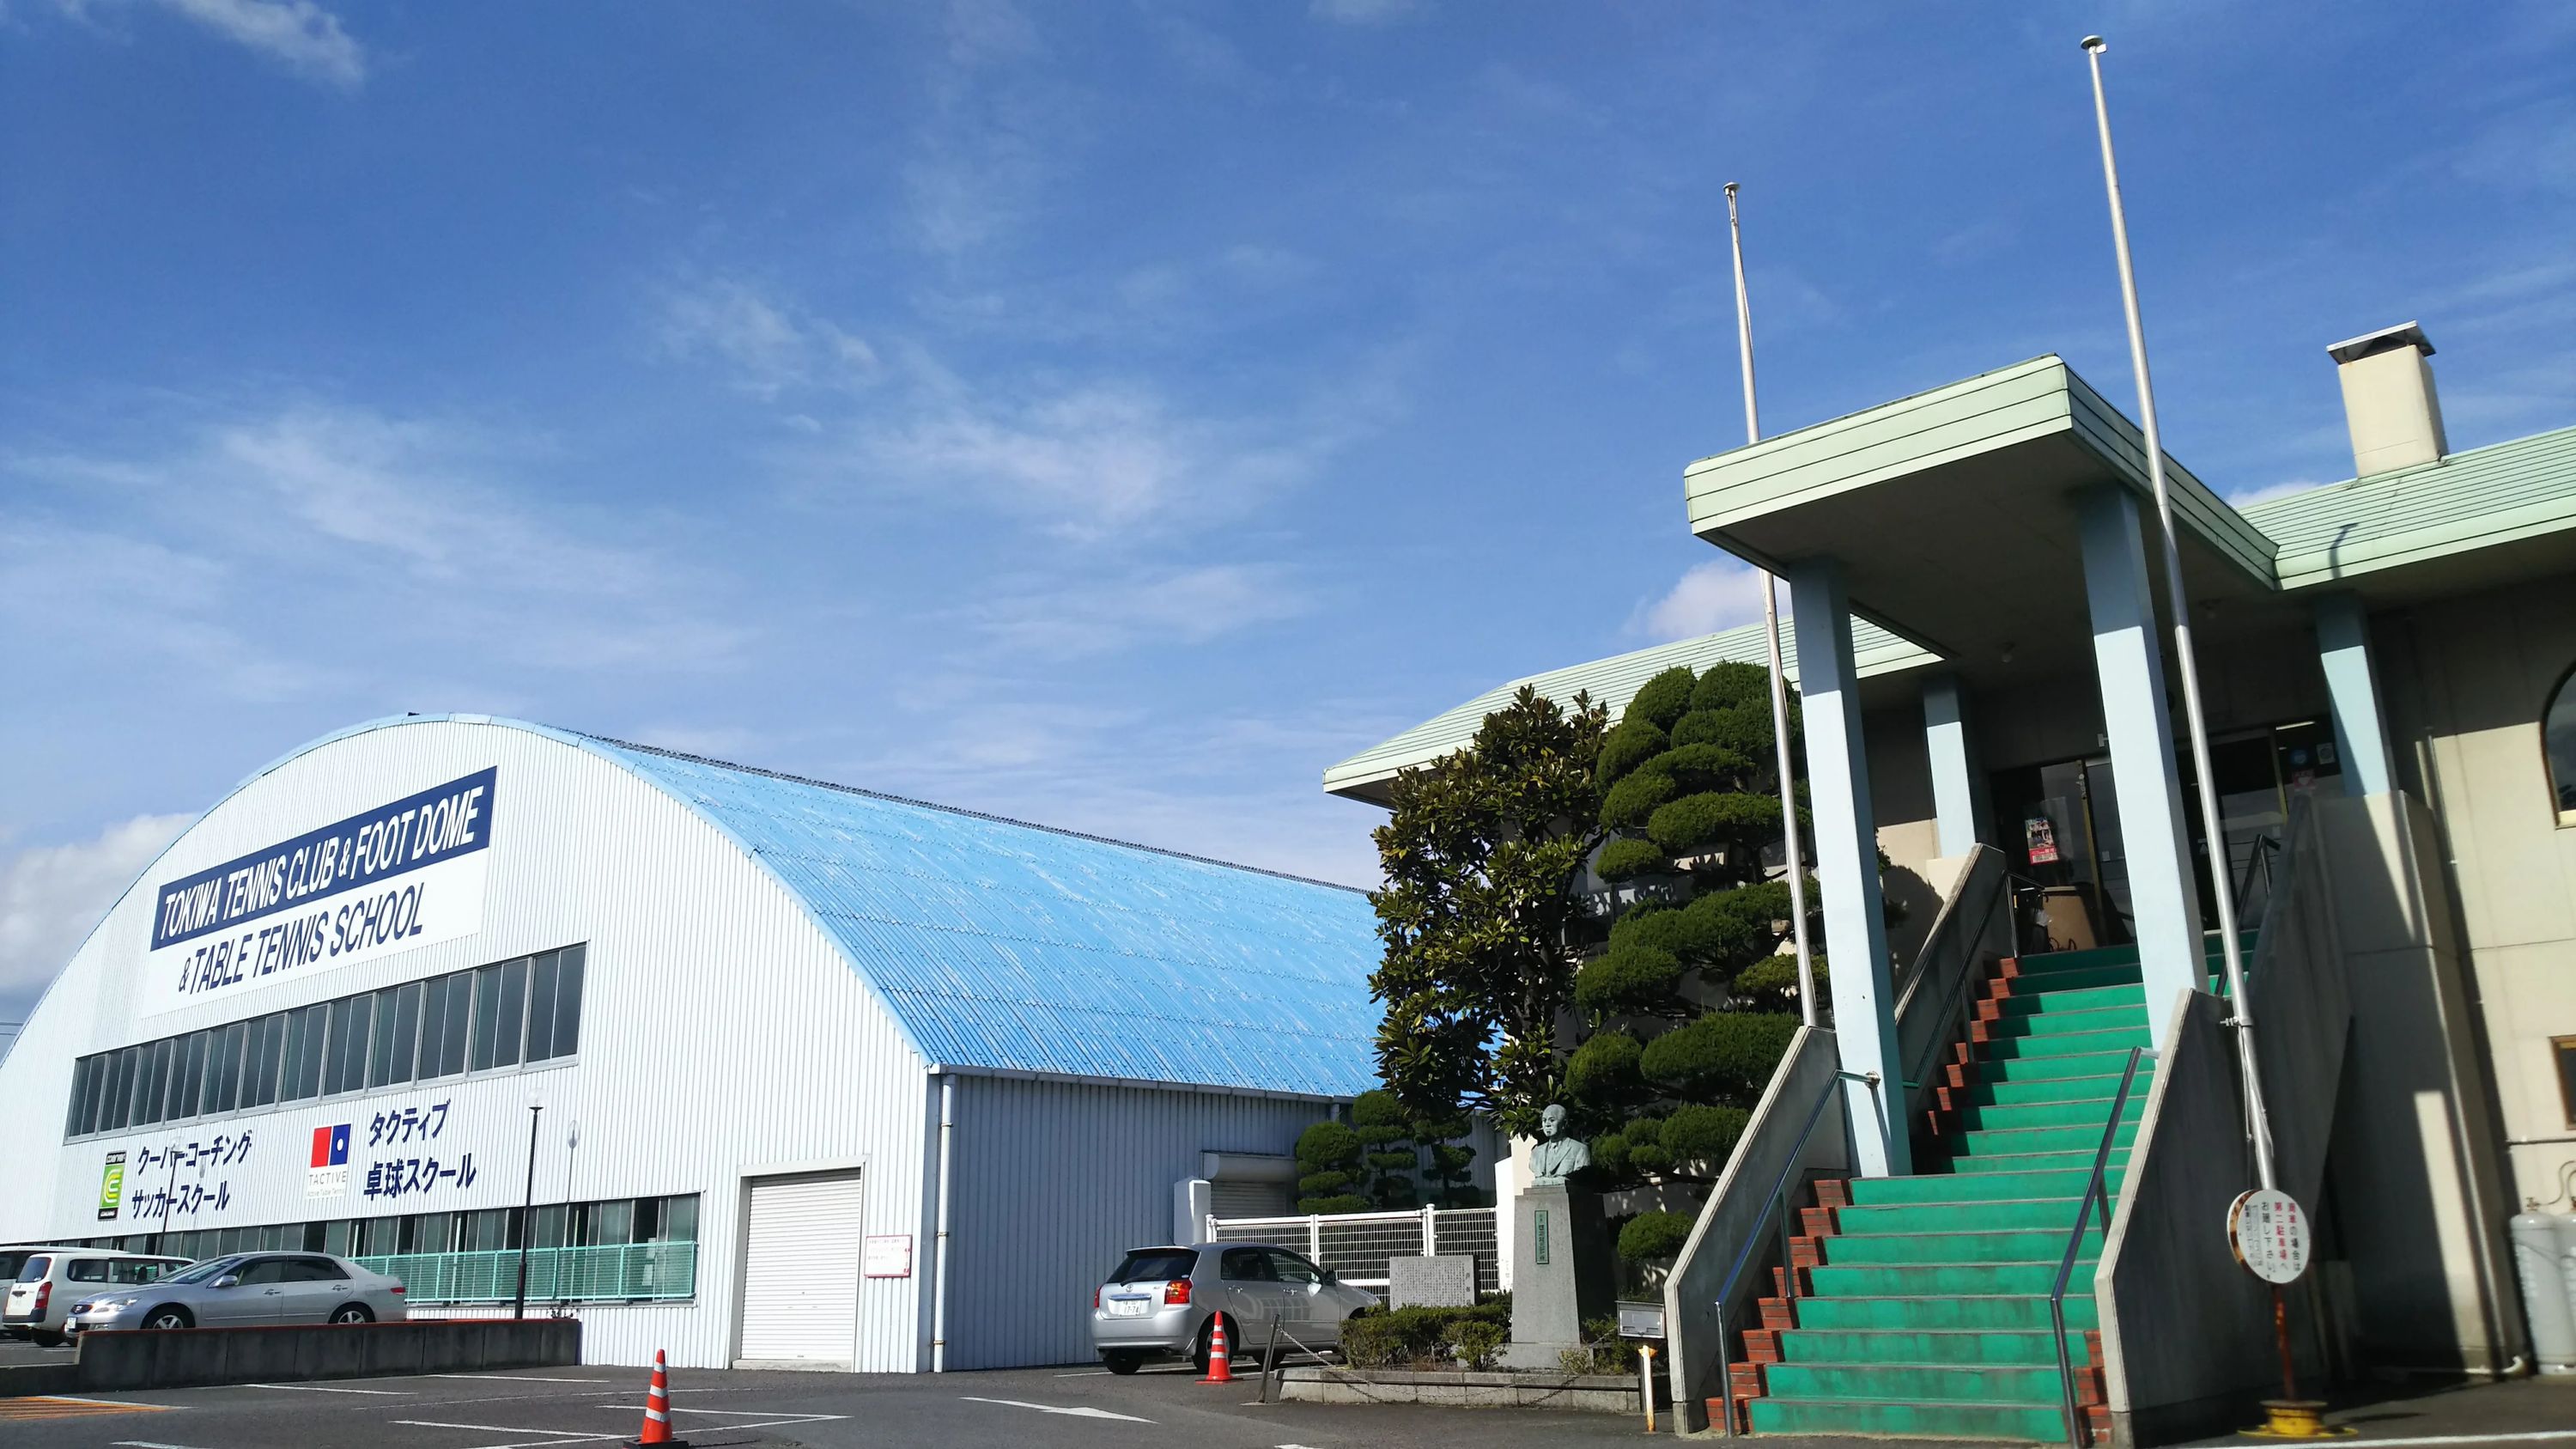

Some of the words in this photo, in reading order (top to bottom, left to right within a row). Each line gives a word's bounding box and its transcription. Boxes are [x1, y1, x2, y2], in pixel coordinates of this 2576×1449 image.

[161, 877, 221, 941] TOKIWA
[222, 857, 287, 920] TENNIS
[286, 835, 340, 898] CLUB
[337, 837, 351, 878] &
[349, 809, 416, 880] FOOT
[412, 785, 484, 860] DOME
[178, 957, 191, 993] &
[189, 933, 253, 995] TABLE
[252, 910, 329, 978] TENNIS
[330, 882, 425, 956] SCHOOL
[369, 1098, 452, 1148] タクティブ
[132, 1180, 230, 1219] サッカースクール
[309, 1171, 348, 1186] TACTIVE
[363, 1153, 477, 1201] 卓球スクール
